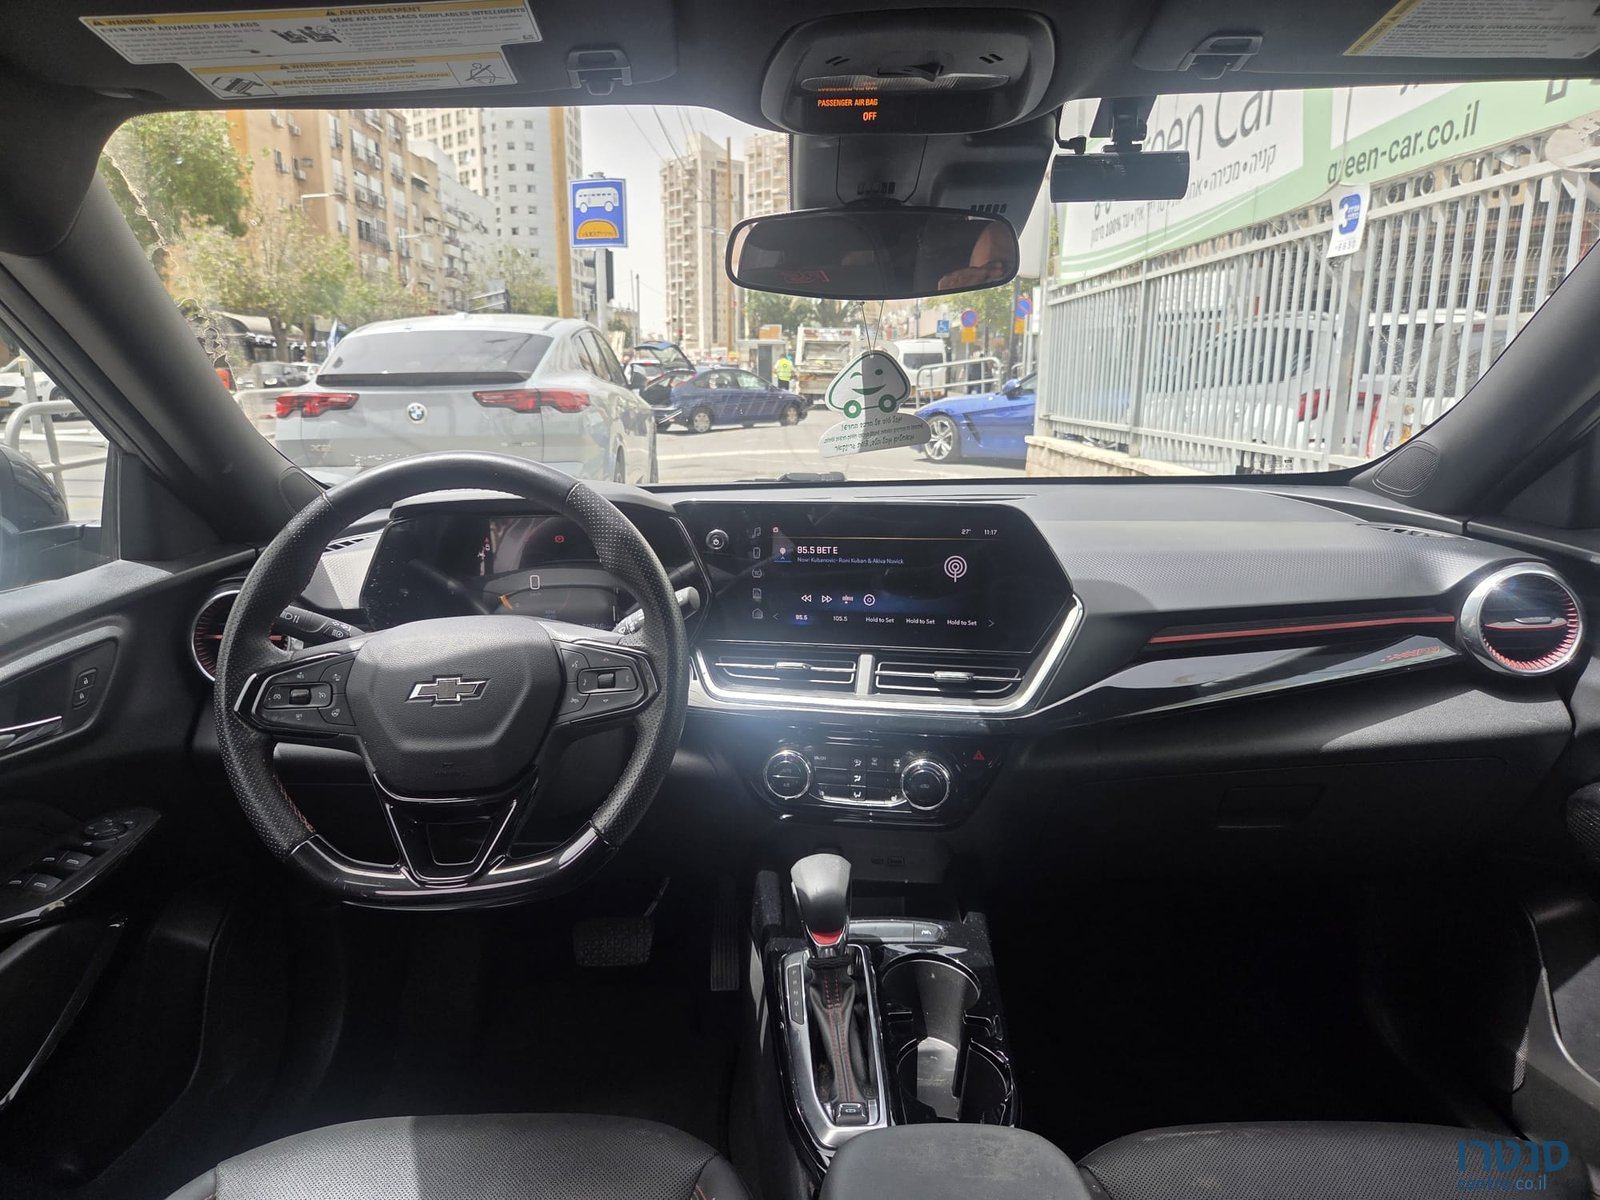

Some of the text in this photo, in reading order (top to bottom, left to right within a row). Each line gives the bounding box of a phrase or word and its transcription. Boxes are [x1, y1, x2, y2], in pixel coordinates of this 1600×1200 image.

[817, 98, 878, 107] PASSENGER AIR BAG
[862, 111, 877, 121] OFF
[797, 545, 839, 554] 95.5 BET E
